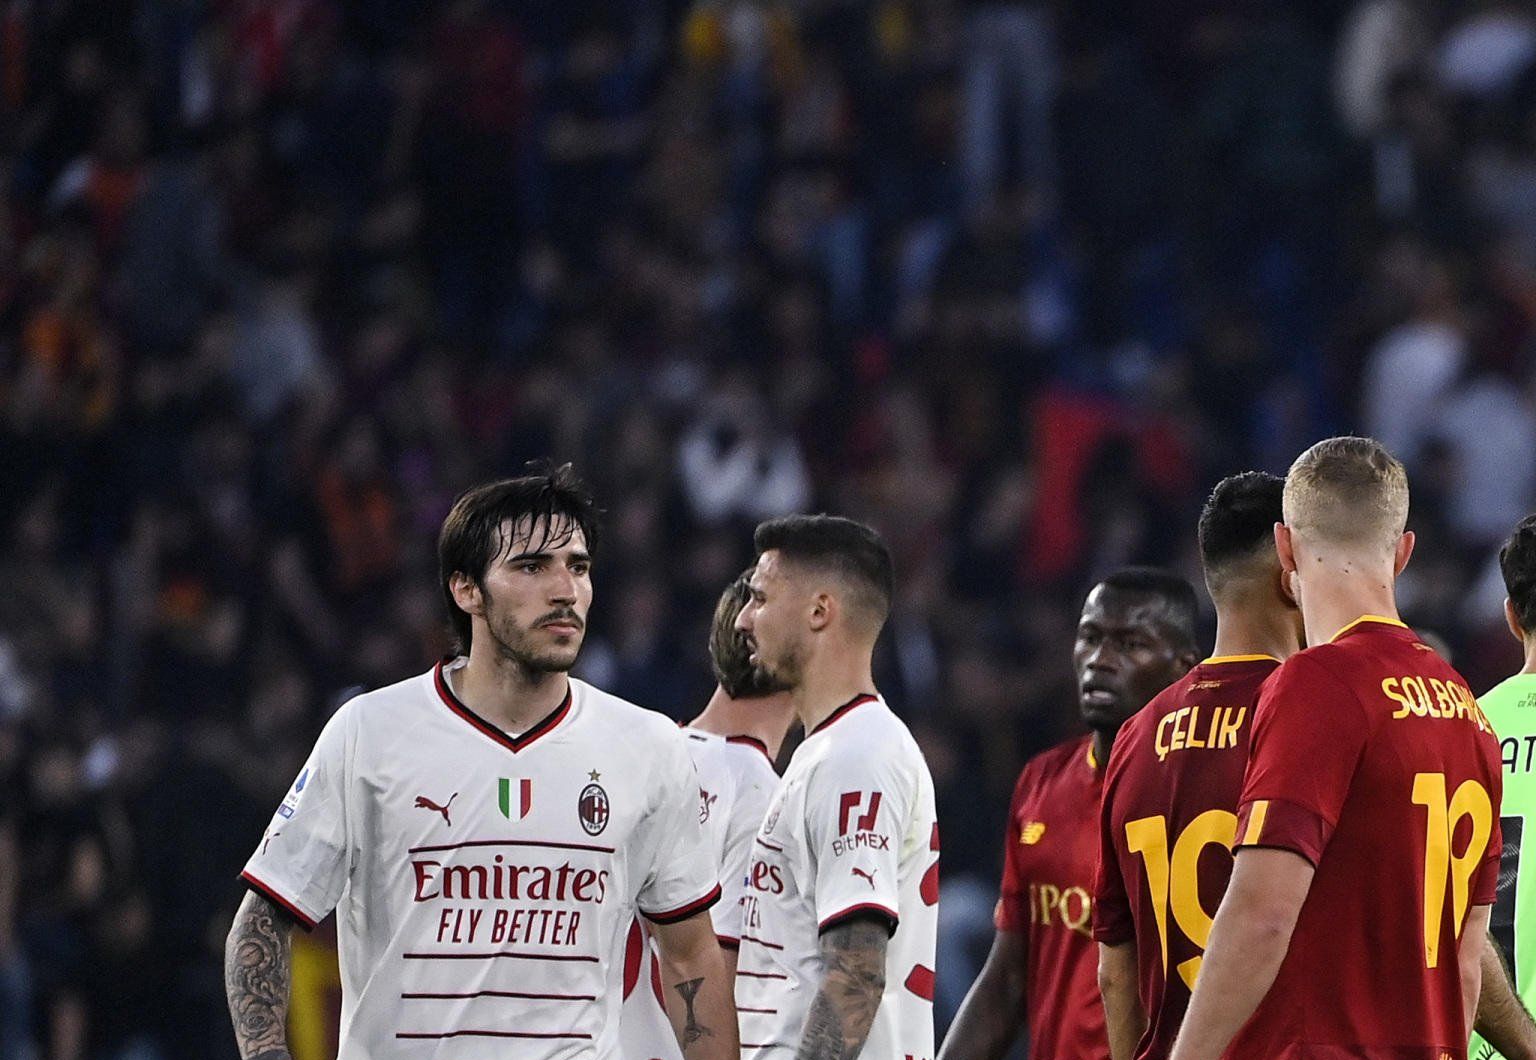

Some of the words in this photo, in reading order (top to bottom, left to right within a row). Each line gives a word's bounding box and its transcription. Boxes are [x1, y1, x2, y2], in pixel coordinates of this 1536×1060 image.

[1155, 706, 1246, 762] ÇELIK
[832, 832, 889, 857] BitMEX
[411, 854, 609, 904] Emirates
[436, 908, 482, 943] FLY
[491, 908, 581, 946] BETTER
